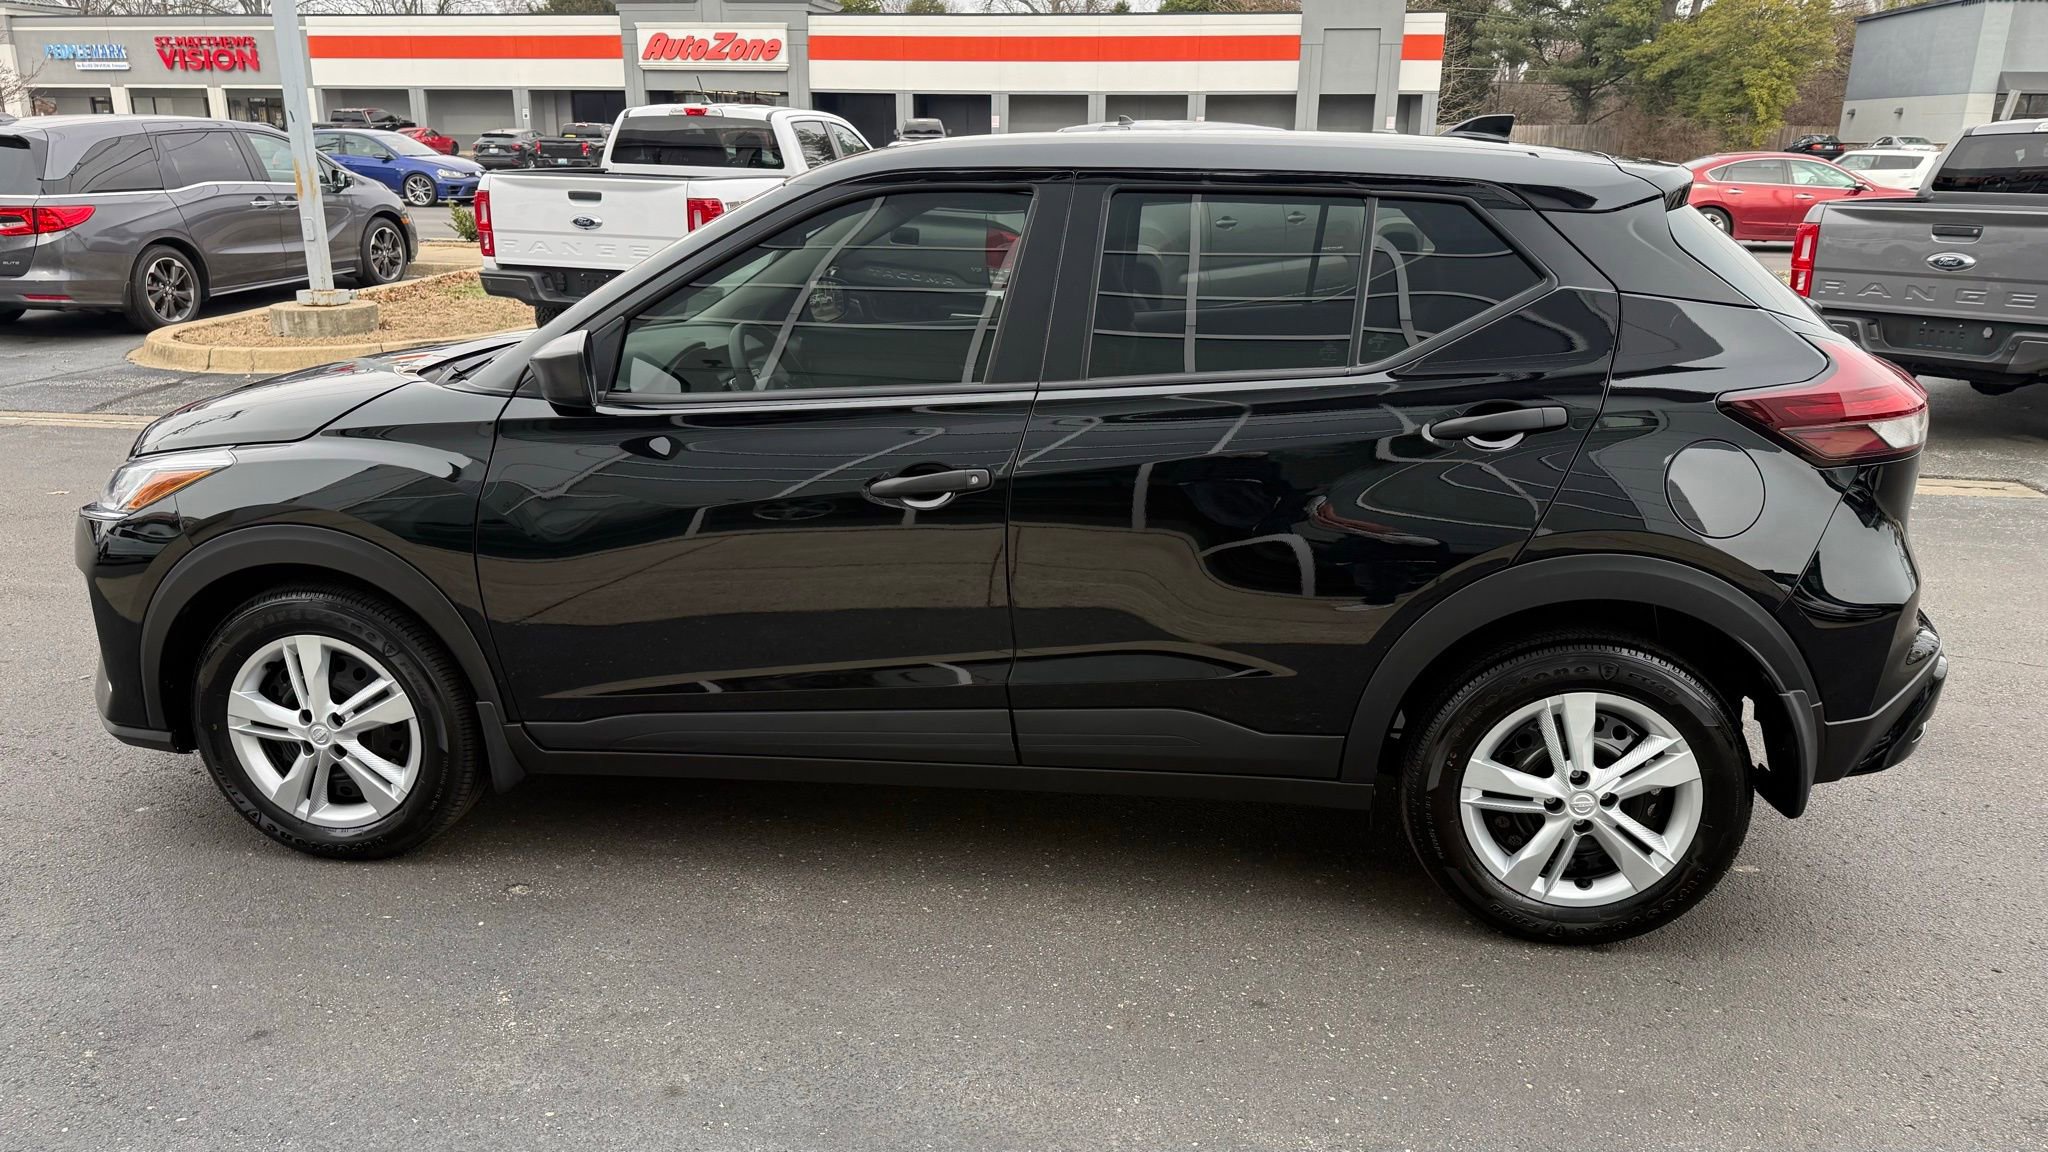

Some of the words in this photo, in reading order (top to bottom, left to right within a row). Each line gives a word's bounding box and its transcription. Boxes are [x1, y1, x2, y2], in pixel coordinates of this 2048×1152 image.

[175, 36, 256, 48] MATTHEWS
[641, 32, 782, 61] AutoZone
[156, 48, 260, 71] VISION
